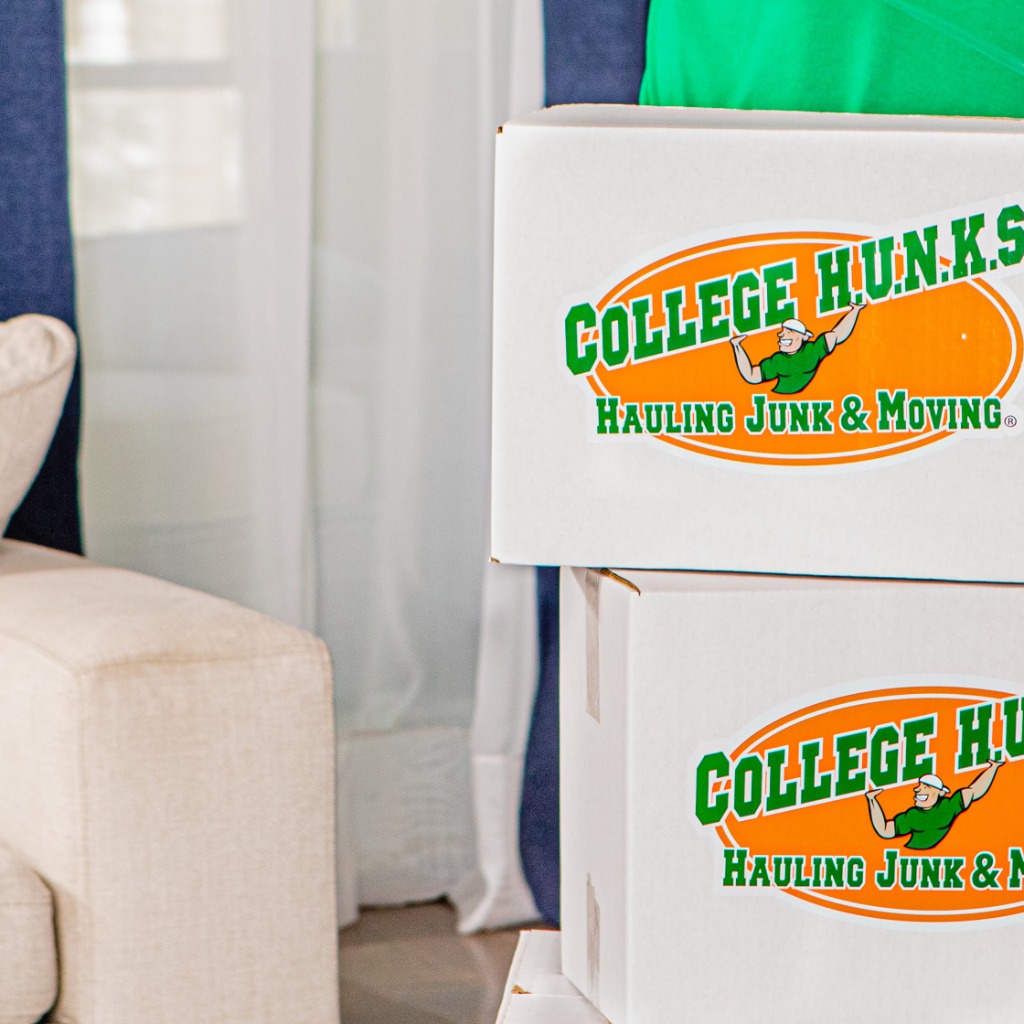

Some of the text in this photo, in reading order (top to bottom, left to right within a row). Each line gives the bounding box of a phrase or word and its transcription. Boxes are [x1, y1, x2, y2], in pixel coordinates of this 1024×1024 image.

[565, 260, 797, 376] COLLEGE
[596, 397, 734, 435] HAULING
[746, 394, 833, 433] JUNK
[841, 399, 870, 432] &
[695, 715, 937, 826] COLLEGE
[723, 849, 865, 888] HAULING
[877, 850, 967, 889] JUNK
[973, 852, 1001, 889] &
